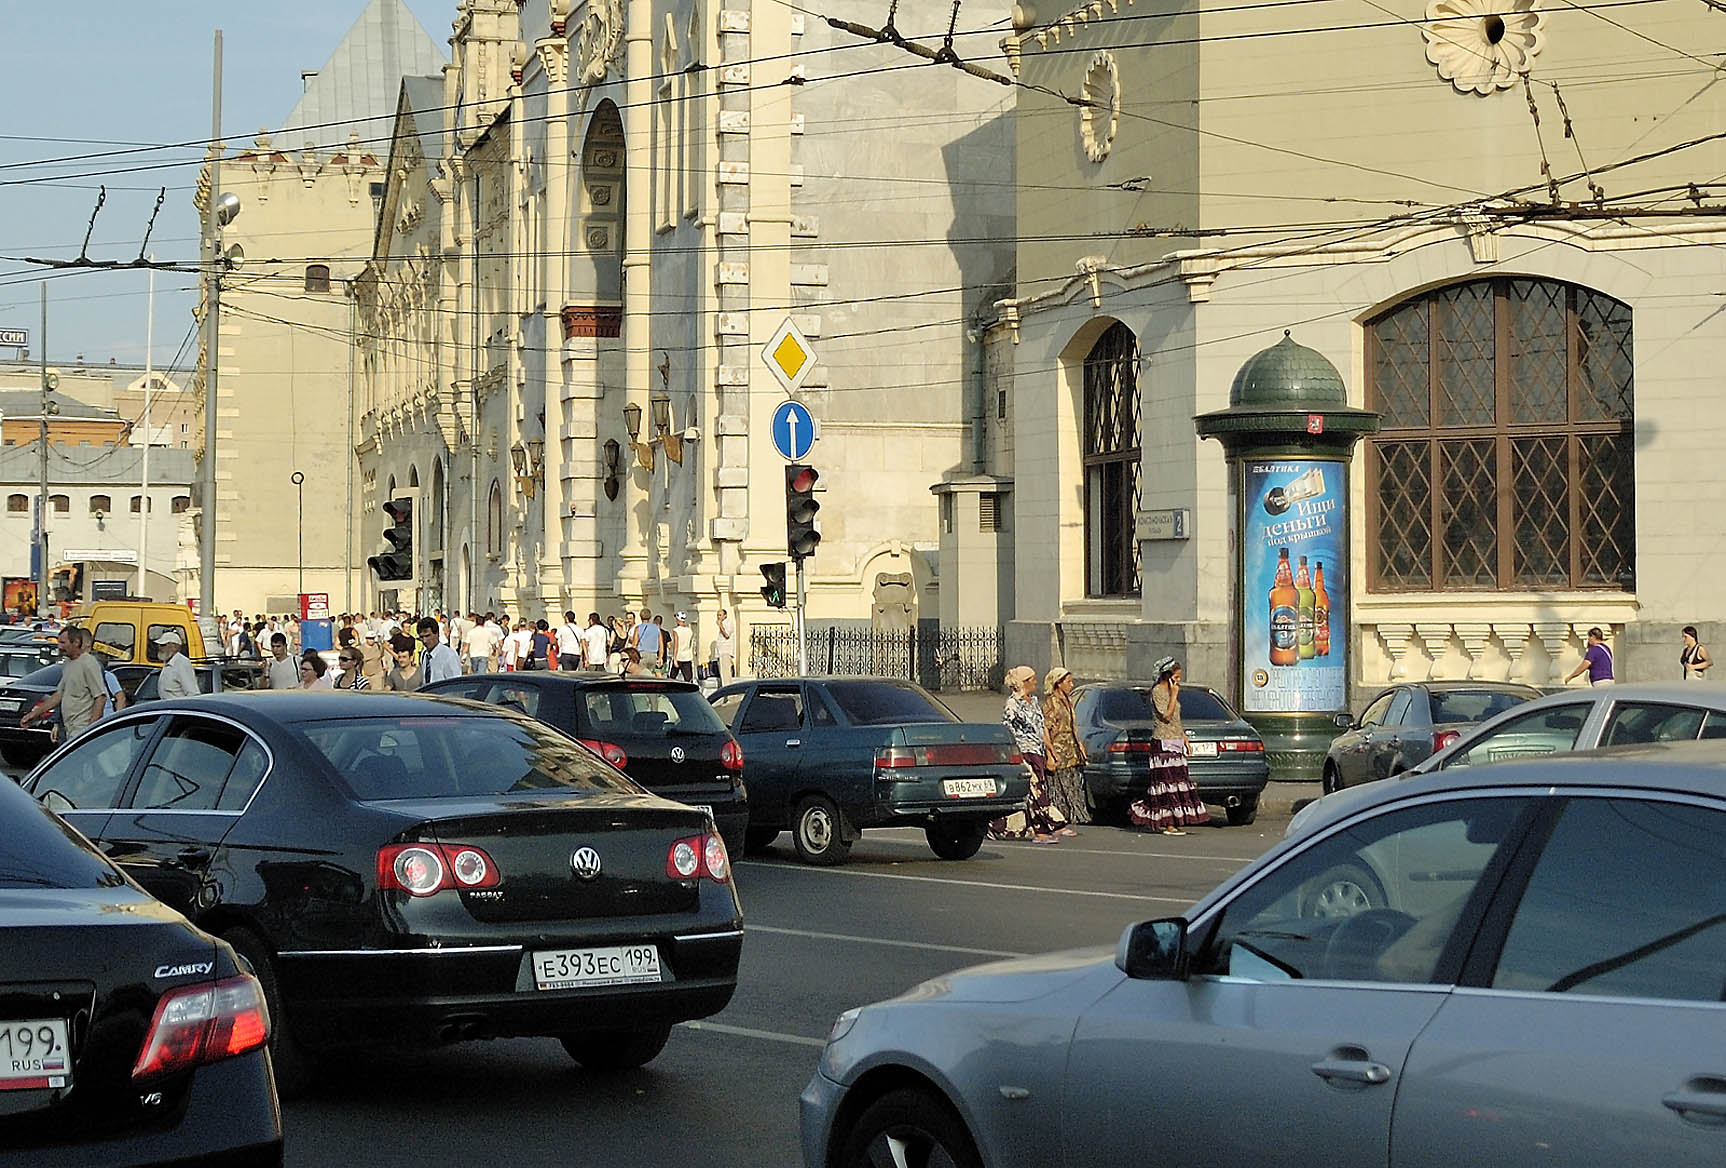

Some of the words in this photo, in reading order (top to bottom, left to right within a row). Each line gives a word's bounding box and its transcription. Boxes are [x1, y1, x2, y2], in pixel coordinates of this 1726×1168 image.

[1297, 498, 1336, 516] Ищи
[1176, 515, 1183, 532] 2
[1262, 514, 1327, 540] деньги
[1268, 537, 1287, 546] под
[1287, 527, 1332, 544] крышкой
[625, 948, 653, 967] 199
[154, 961, 213, 978] CAMRY
[0, 1026, 55, 1057] 199
[12, 1059, 41, 1071] RUS
[140, 1092, 162, 1105] V6
